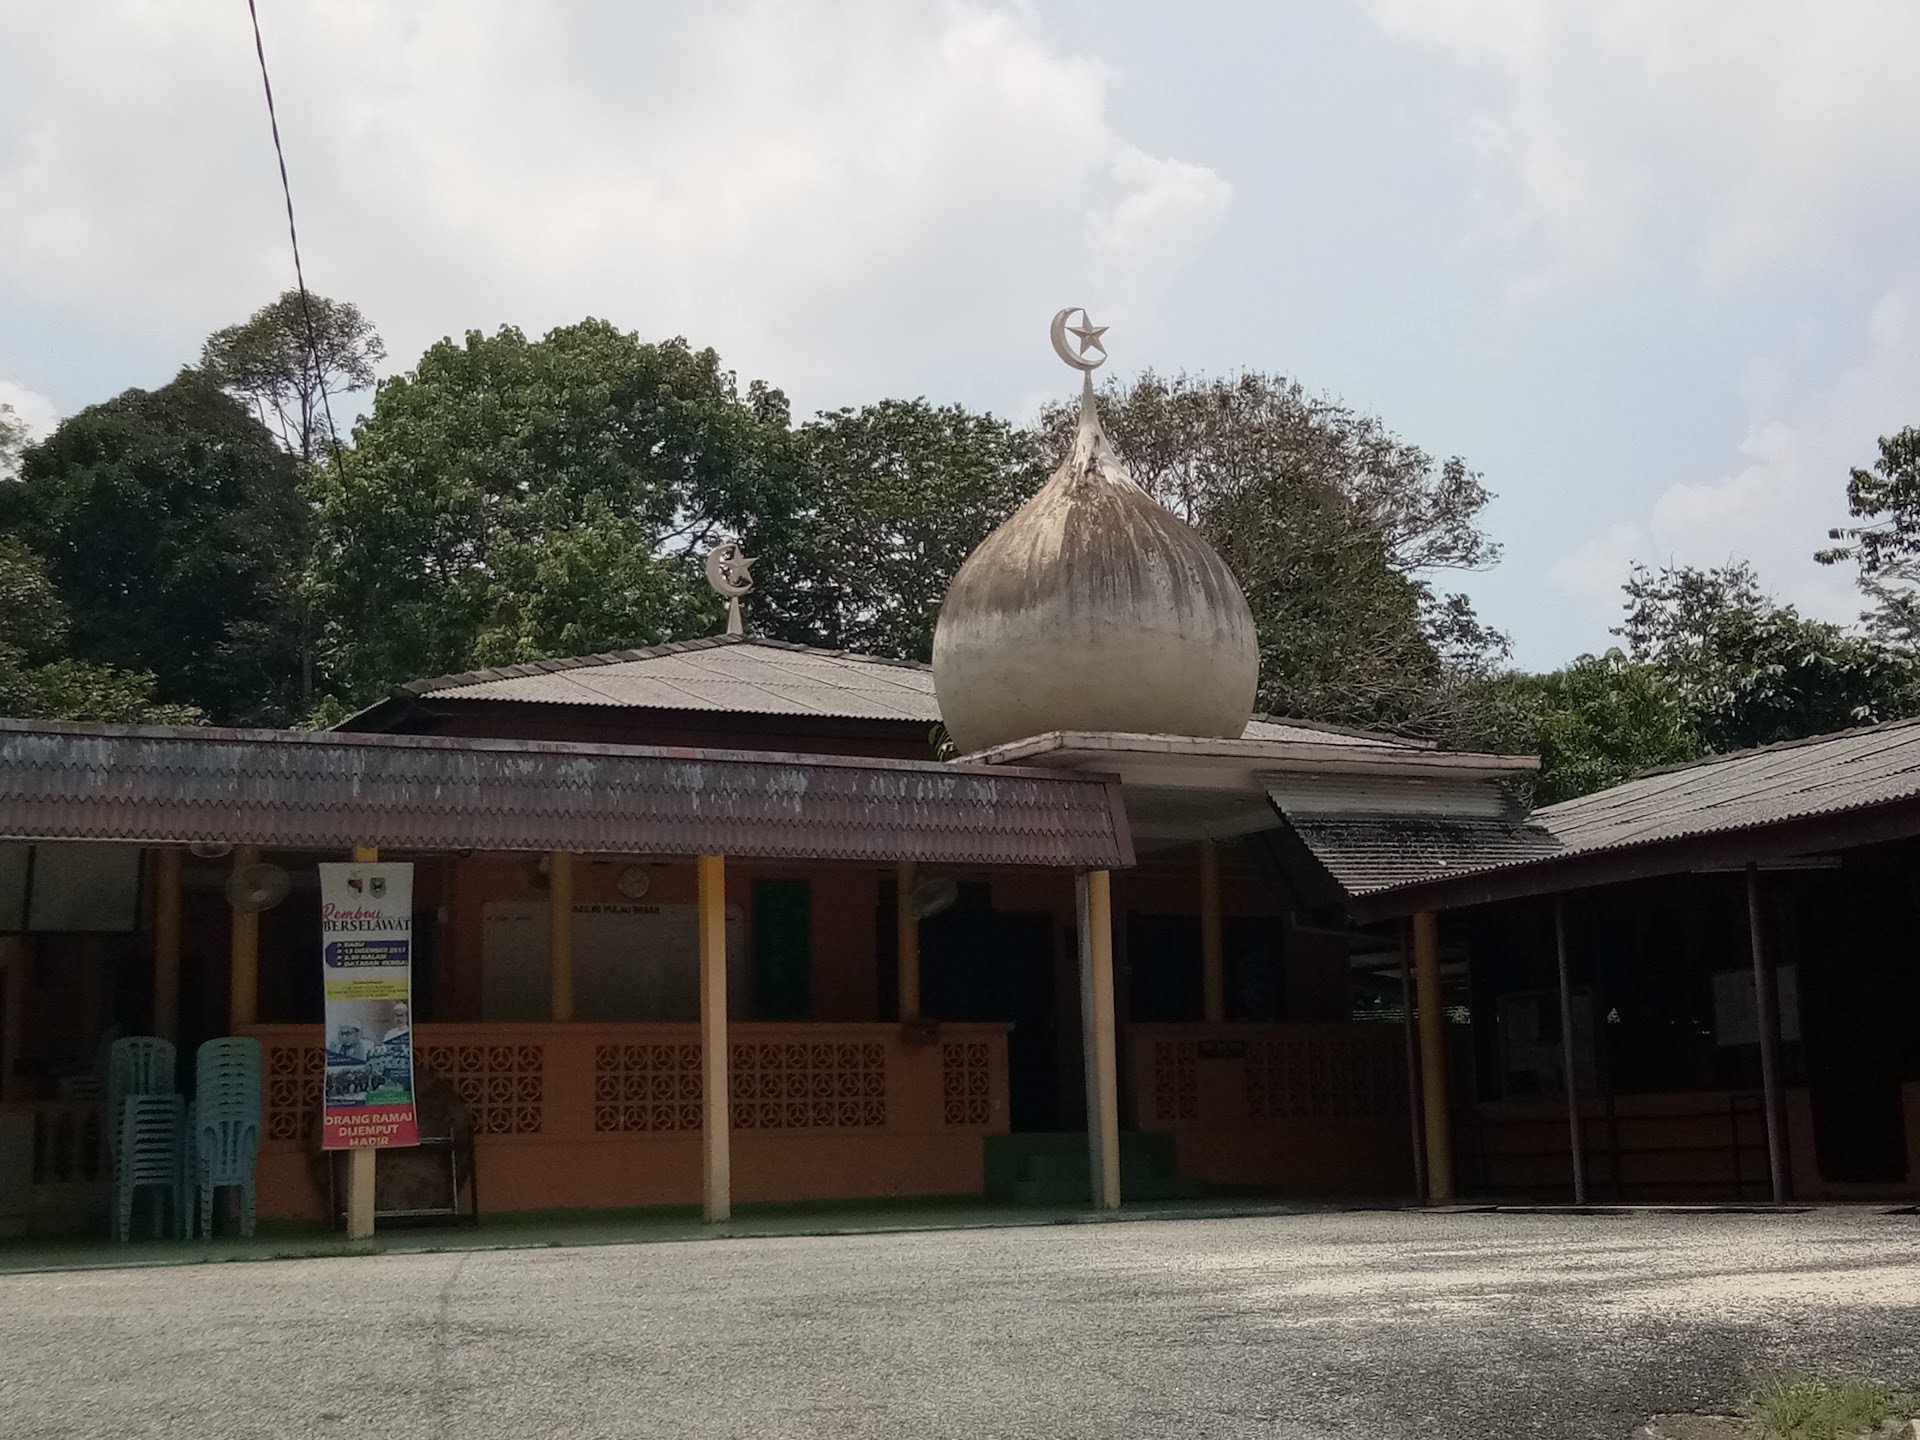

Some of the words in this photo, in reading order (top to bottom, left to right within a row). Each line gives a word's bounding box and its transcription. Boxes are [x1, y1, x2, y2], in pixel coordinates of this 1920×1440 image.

[603, 905, 631, 913] PULAU
[324, 919, 411, 932] BERSELAWAT
[325, 1115, 370, 1125] ORANG
[372, 1112, 413, 1124] RAMAI
[339, 1125, 399, 1136] DIJEMPUT
[350, 1137, 389, 1146] HADIR
